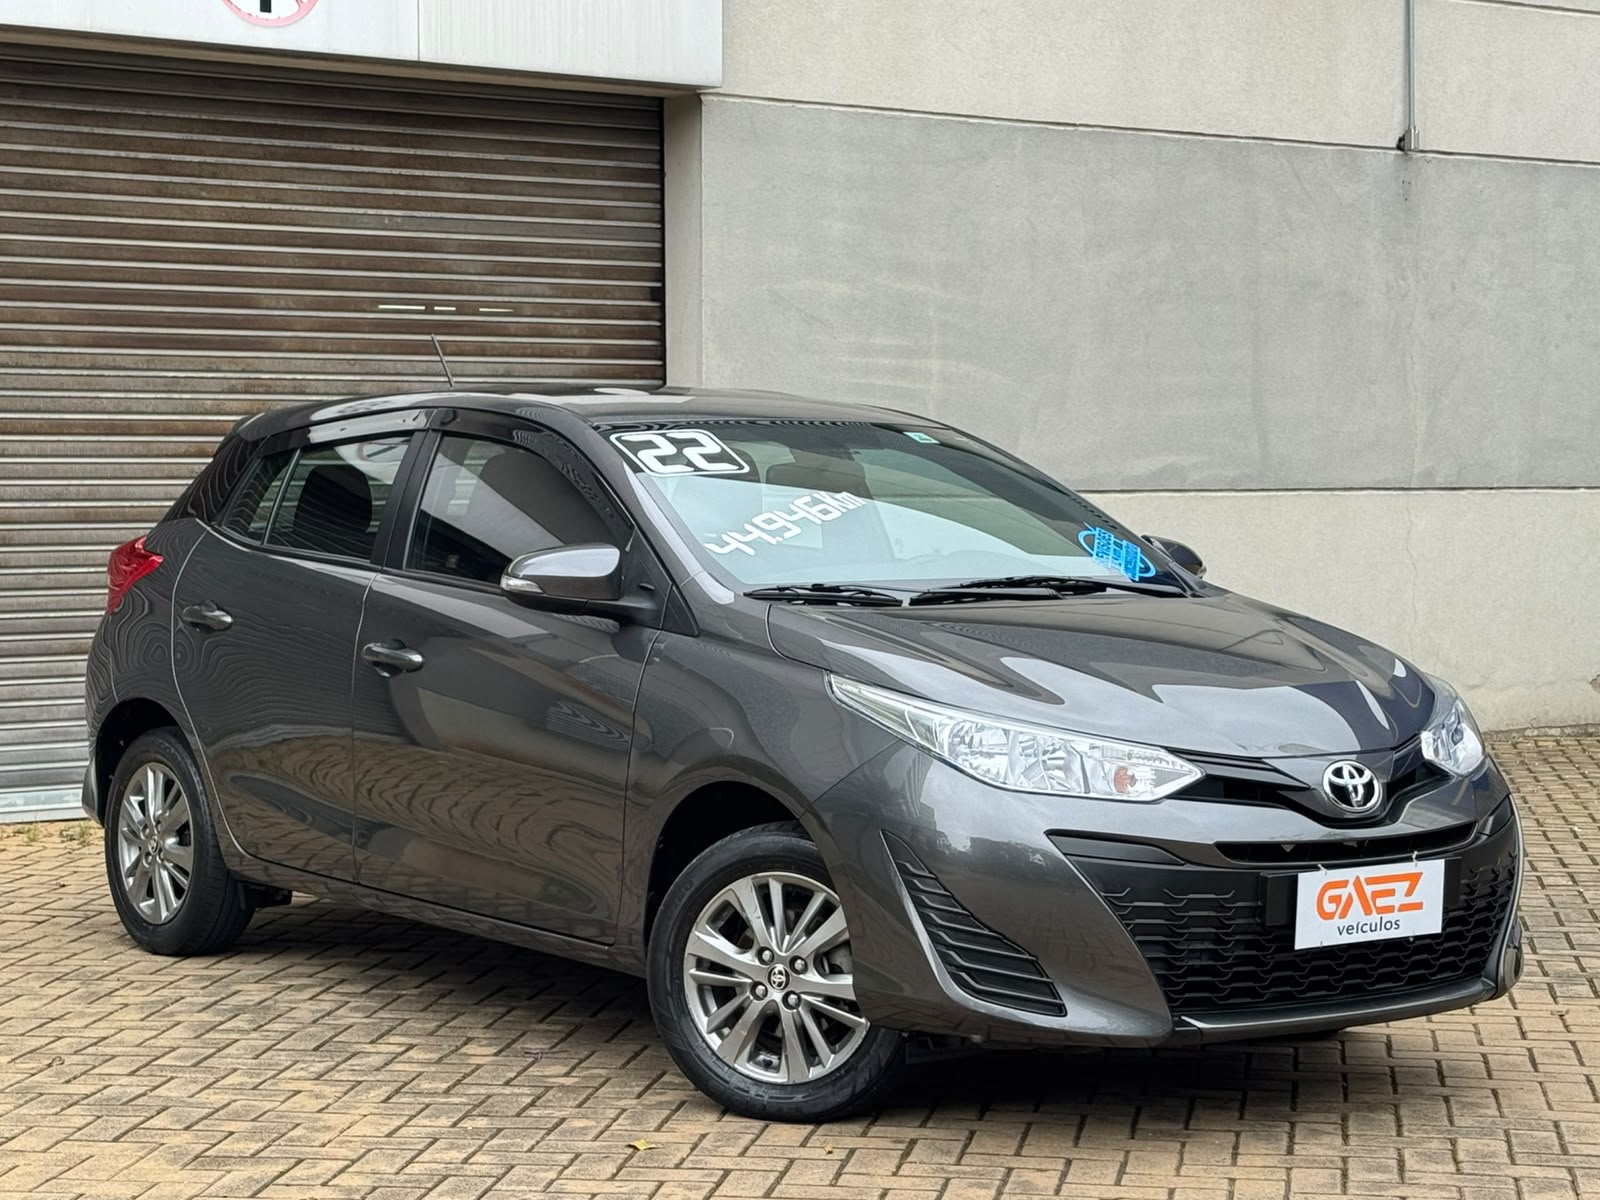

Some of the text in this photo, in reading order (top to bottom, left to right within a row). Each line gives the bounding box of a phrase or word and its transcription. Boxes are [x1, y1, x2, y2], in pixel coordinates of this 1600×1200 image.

[620, 432, 739, 473] 22
[1316, 872, 1424, 921] GAEZ
[1337, 916, 1401, 936] veículos
